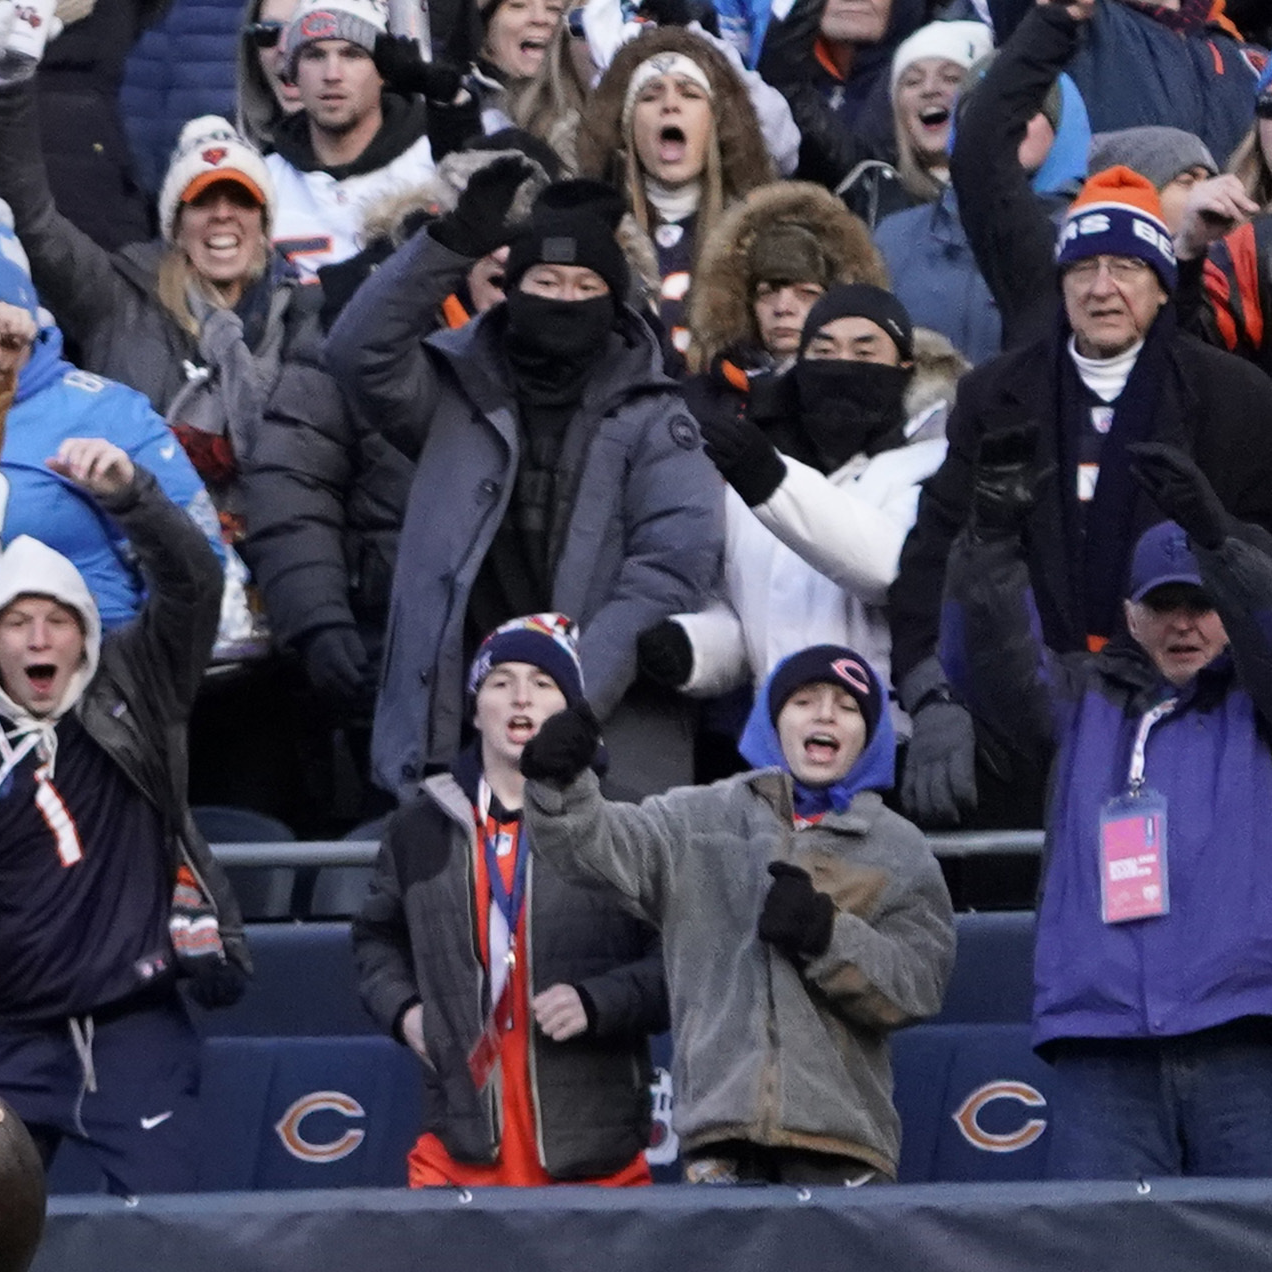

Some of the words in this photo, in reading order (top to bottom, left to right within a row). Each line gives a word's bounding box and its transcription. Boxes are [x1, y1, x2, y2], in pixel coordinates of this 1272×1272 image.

[830, 658, 870, 695] C
[33, 762, 85, 868] 1
[275, 1091, 365, 1163] C
[952, 1081, 1047, 1153] C
